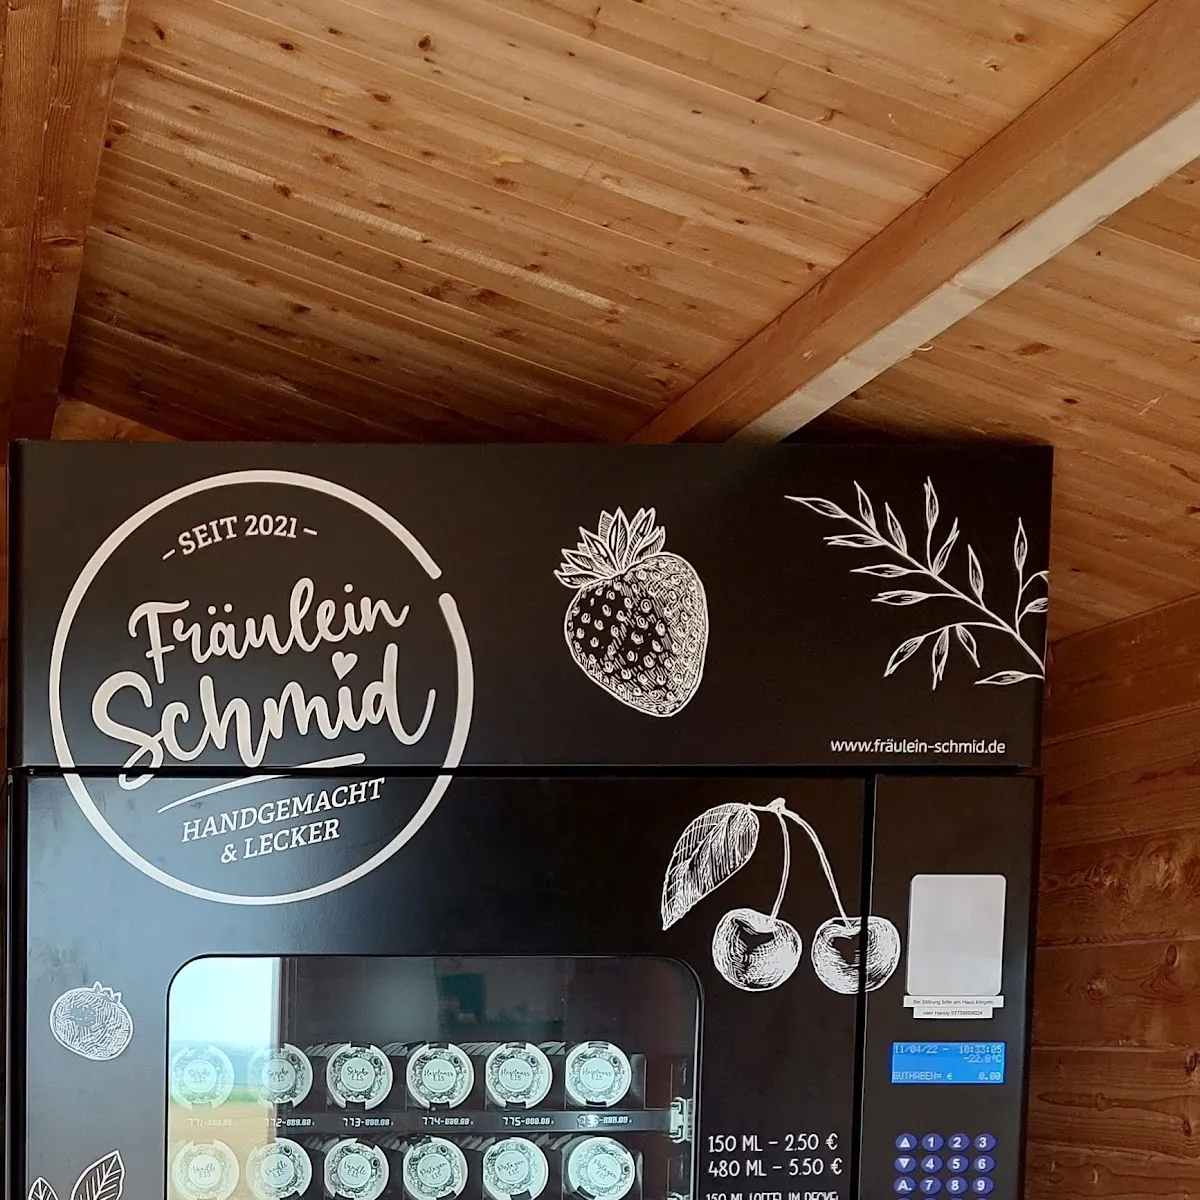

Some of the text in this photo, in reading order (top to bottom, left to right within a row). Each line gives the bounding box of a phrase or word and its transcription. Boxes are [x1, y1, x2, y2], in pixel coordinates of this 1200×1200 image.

[178, 514, 297, 555] SEIT 2021
[128, 577, 409, 684] Fräulein
[91, 643, 436, 791] Schmid
[831, 737, 1006, 754] www.fräulein-schmid.de
[181, 778, 386, 843] HANDGEMACHT
[220, 819, 340, 864] & LECKER
[894, 1045, 1002, 1054] 11/04/22 10:33:05
[978, 1072, 1001, 1081] 0.00
[708, 1132, 838, 1153] 150 ML 2.50 €
[928, 1137, 987, 1148] 1 2 3
[708, 1160, 740, 1178] 480
[746, 1159, 767, 1177] ML
[830, 1157, 843, 1176] €
[926, 1158, 986, 1170] 4 5 6
[925, 1180, 934, 1191] 7
[951, 1180, 959, 1191] 8
[977, 1180, 985, 1191] 9
